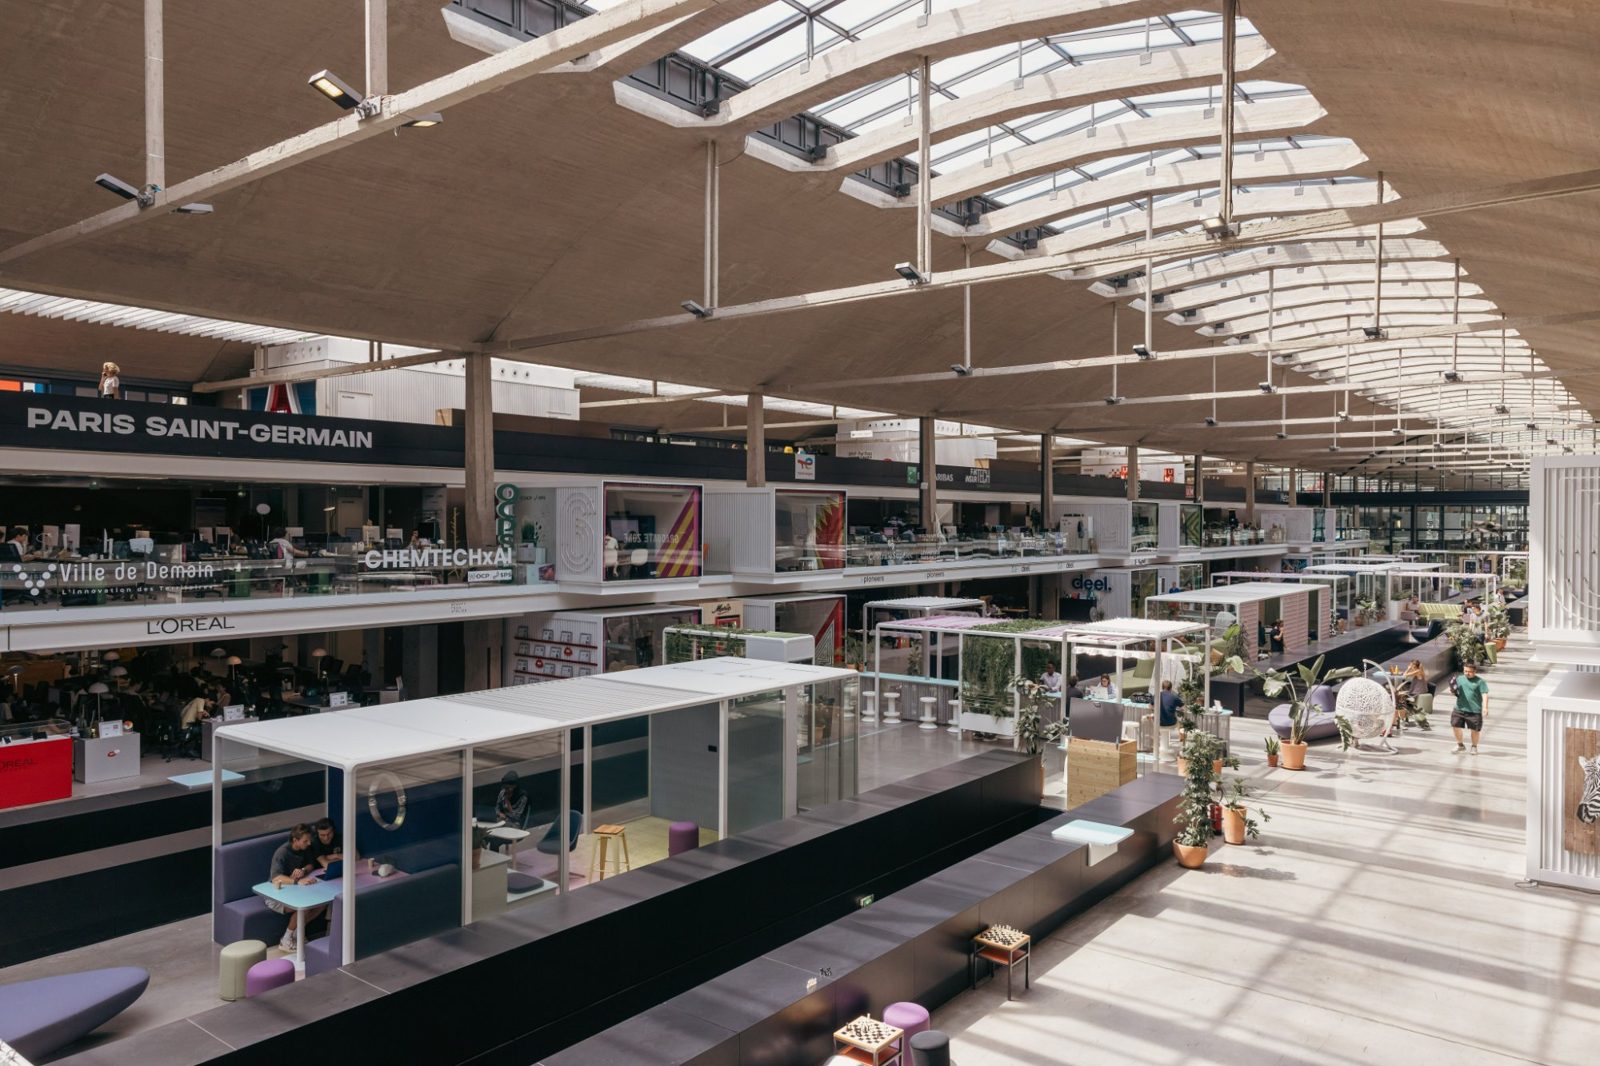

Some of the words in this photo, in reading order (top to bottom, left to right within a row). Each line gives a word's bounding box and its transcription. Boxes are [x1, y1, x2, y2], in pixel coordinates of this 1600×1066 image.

[27, 407, 136, 435] PARIS
[146, 416, 373, 449] SAINT-GERMAIN
[365, 547, 513, 569] CHEMTECHxAI
[59, 562, 105, 582] Ville
[115, 562, 138, 580] de
[146, 560, 214, 579] Demain
[137, 585, 154, 594] des
[147, 616, 236, 635] L'ORÉAL
